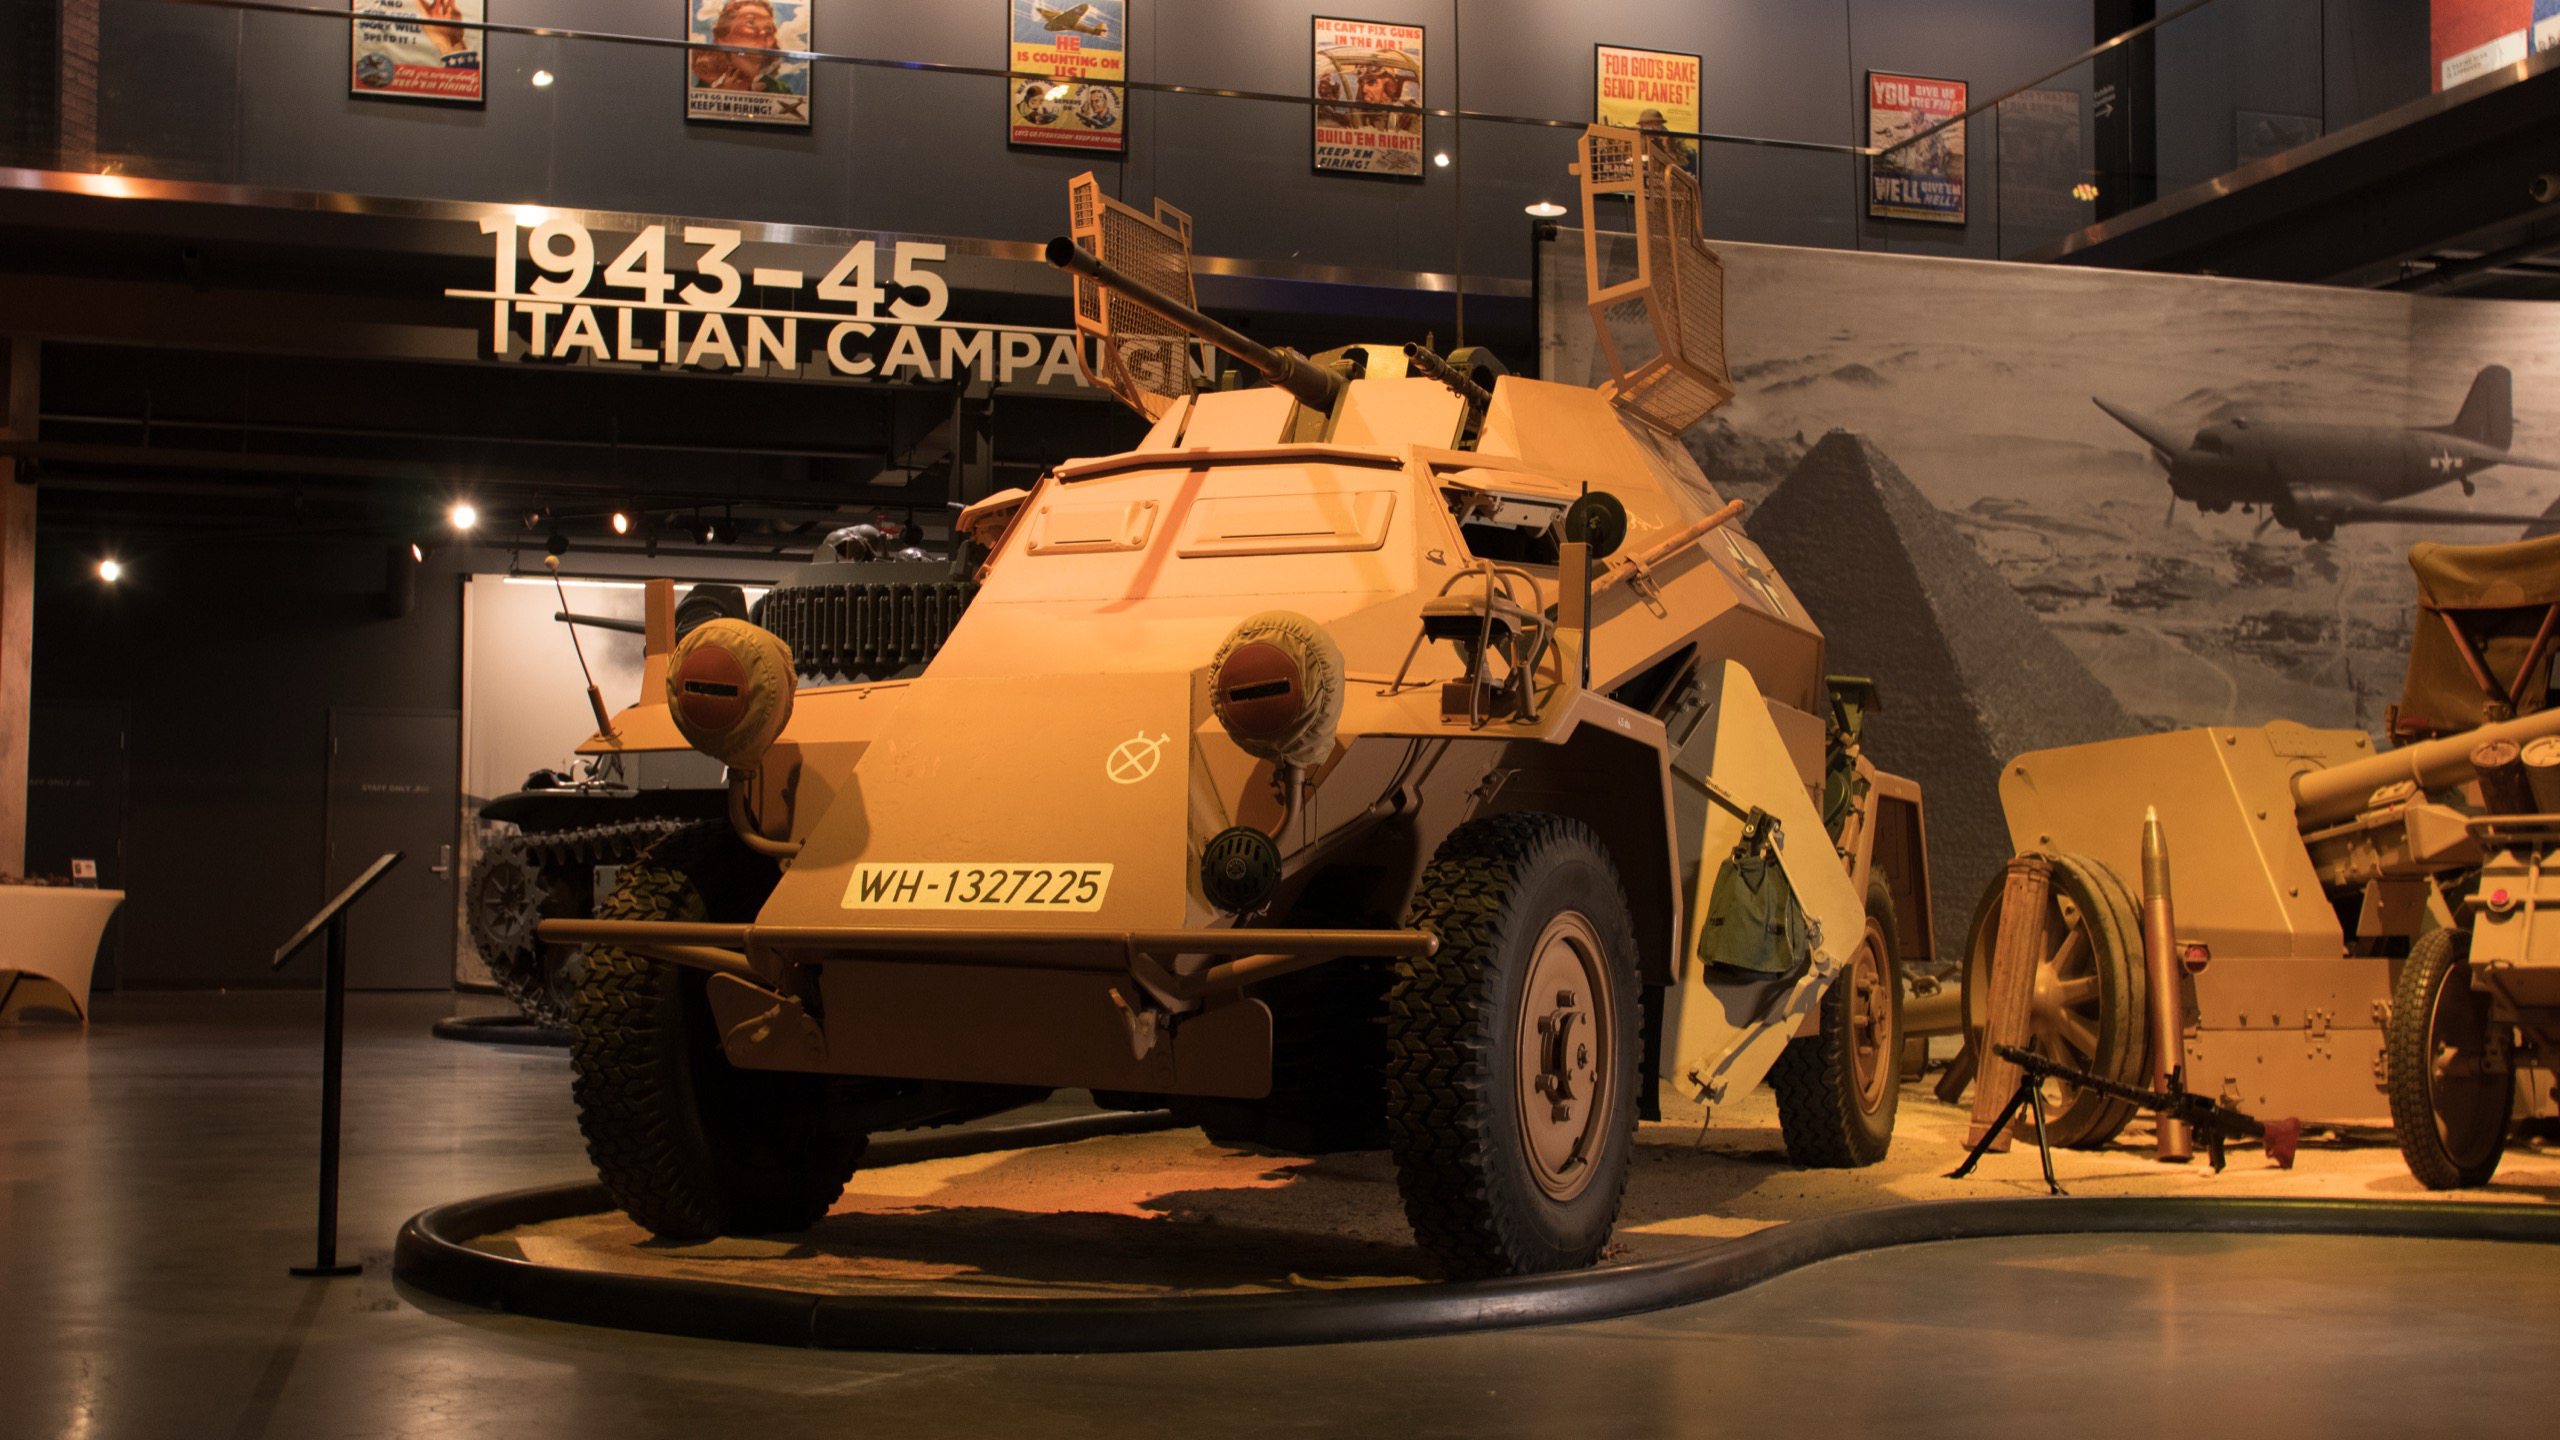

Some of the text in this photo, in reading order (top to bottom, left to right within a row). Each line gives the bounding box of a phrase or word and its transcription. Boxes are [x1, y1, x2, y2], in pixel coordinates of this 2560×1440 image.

[394, 24, 422, 33] WILL
[1316, 20, 1421, 40] HE CAN'T FIX GUNS
[363, 32, 396, 43] SPEED
[1056, 35, 1081, 52] HE
[1335, 35, 1348, 46] IN
[1350, 36, 1372, 48] THE
[1017, 51, 1120, 69] IS COUNTING ON
[1631, 57, 1665, 80] GOD'S
[1666, 60, 1696, 83] SAKE
[1603, 77, 1636, 100] SEND
[1874, 82, 1911, 106] YOU
[1915, 85, 1939, 98] GIVE
[690, 101, 714, 111] KEEP
[733, 103, 773, 115] FIRING!
[1910, 96, 1932, 109] THE
[1317, 128, 1353, 145] BUILD
[1378, 134, 1421, 151] RIGHT!
[1317, 146, 1351, 157] KEEP
[1319, 157, 1371, 170] FIRING!
[1873, 176, 1922, 205] WE'LL
[1923, 194, 1959, 208] HELL!
[493, 299, 797, 370] ITALIAN
[860, 869, 1102, 904] WH-1327225
